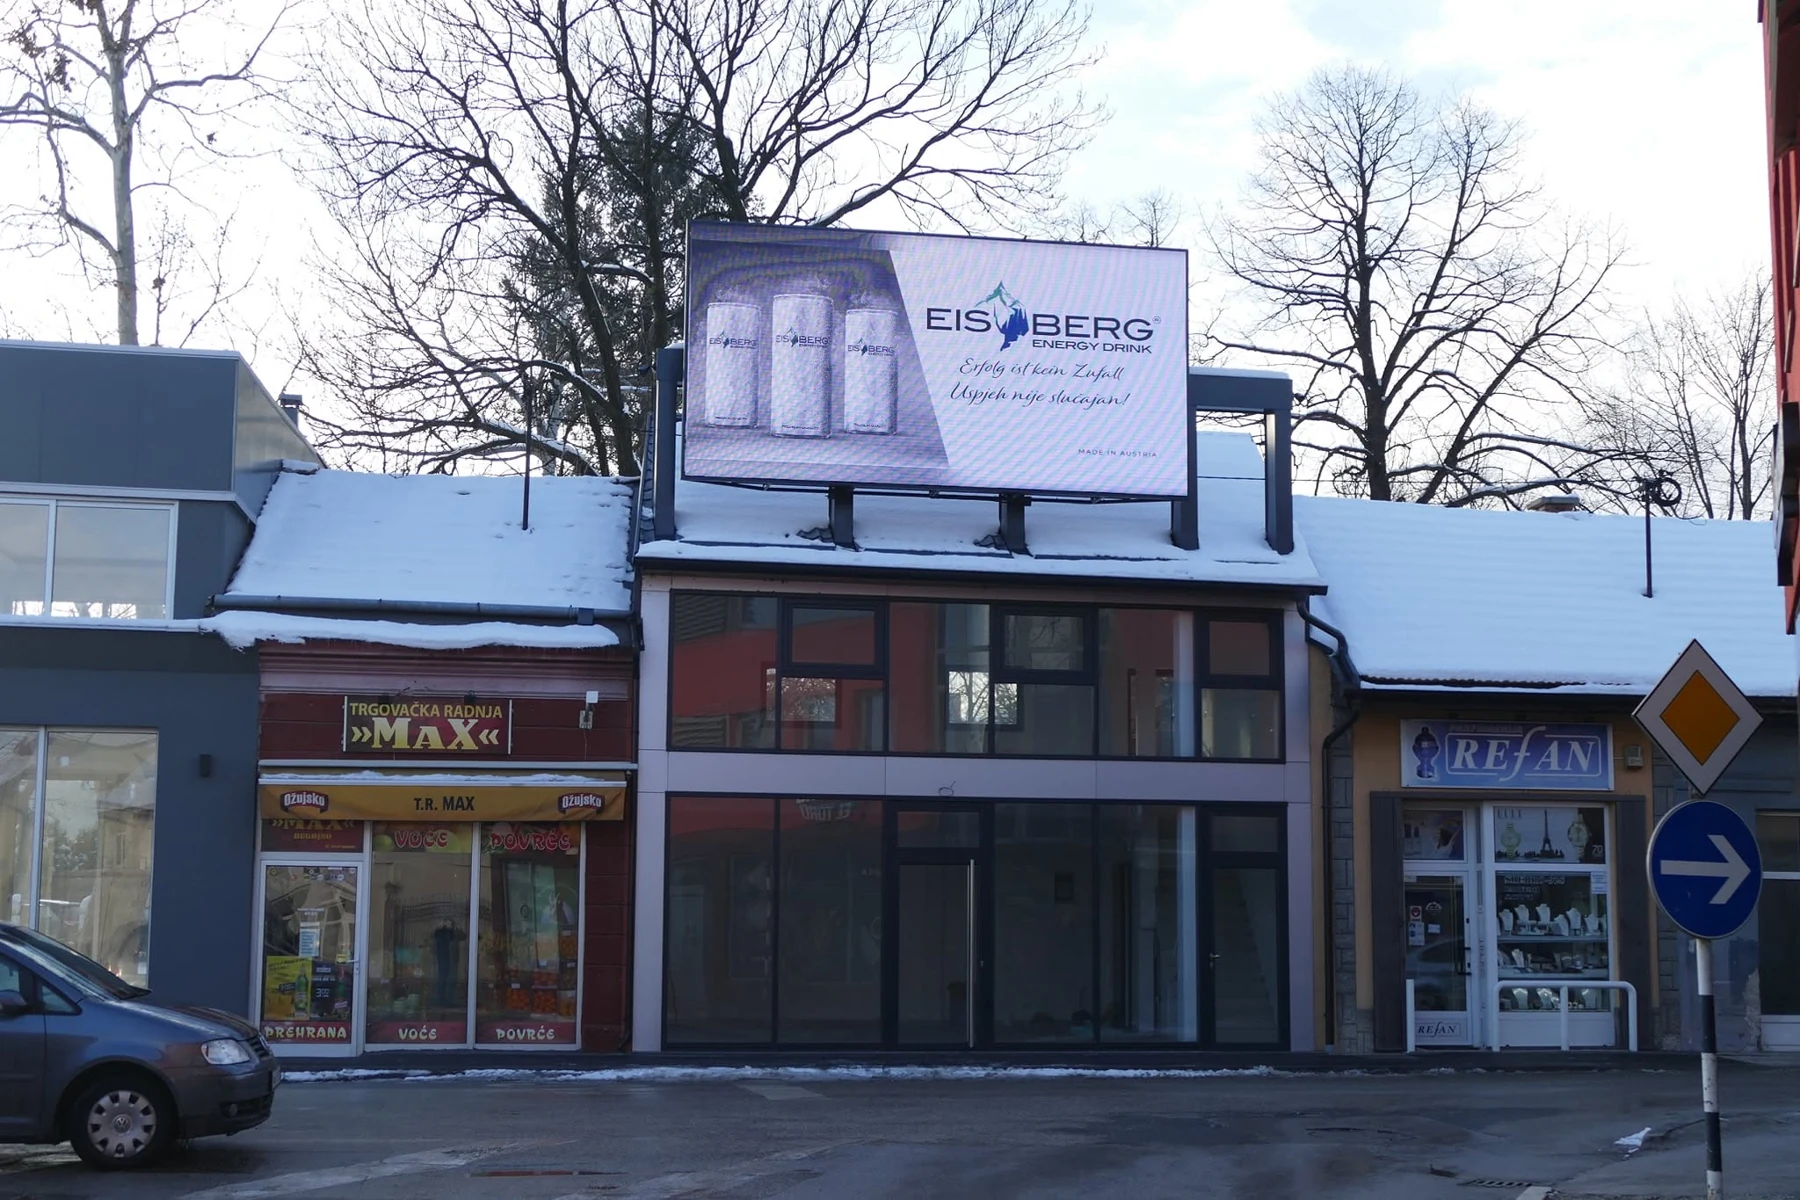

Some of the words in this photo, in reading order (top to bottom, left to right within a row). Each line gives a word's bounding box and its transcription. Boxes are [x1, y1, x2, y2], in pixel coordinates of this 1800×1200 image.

[927, 307, 991, 332] EIS
[1032, 313, 1153, 341] BERG
[1032, 339, 1099, 351] ENERGY
[1103, 343, 1153, 354] DRINK
[959, 358, 1006, 379] Erfolg
[1011, 362, 1031, 376] ist
[1032, 362, 1068, 376] kein
[1072, 363, 1125, 383] Zufall
[950, 381, 1008, 405] Uspjeh
[1012, 389, 1047, 407] nije
[1048, 390, 1131, 410] slučajan!
[1119, 450, 1157, 458] AUSTRIA
[350, 702, 440, 717] TRGOVAČKA
[444, 704, 503, 718] RADNJA
[284, 791, 325, 806] Ožujsko
[414, 798, 438, 811] T.R.
[443, 796, 475, 811] MAX
[562, 793, 602, 808] Ožujsko
[395, 827, 448, 848] VOĆE
[490, 828, 571, 850] POVRĆE
[264, 1025, 347, 1039] PREHRANA
[398, 1025, 437, 1040] VOĆE
[496, 1025, 555, 1040] POVRĆE
